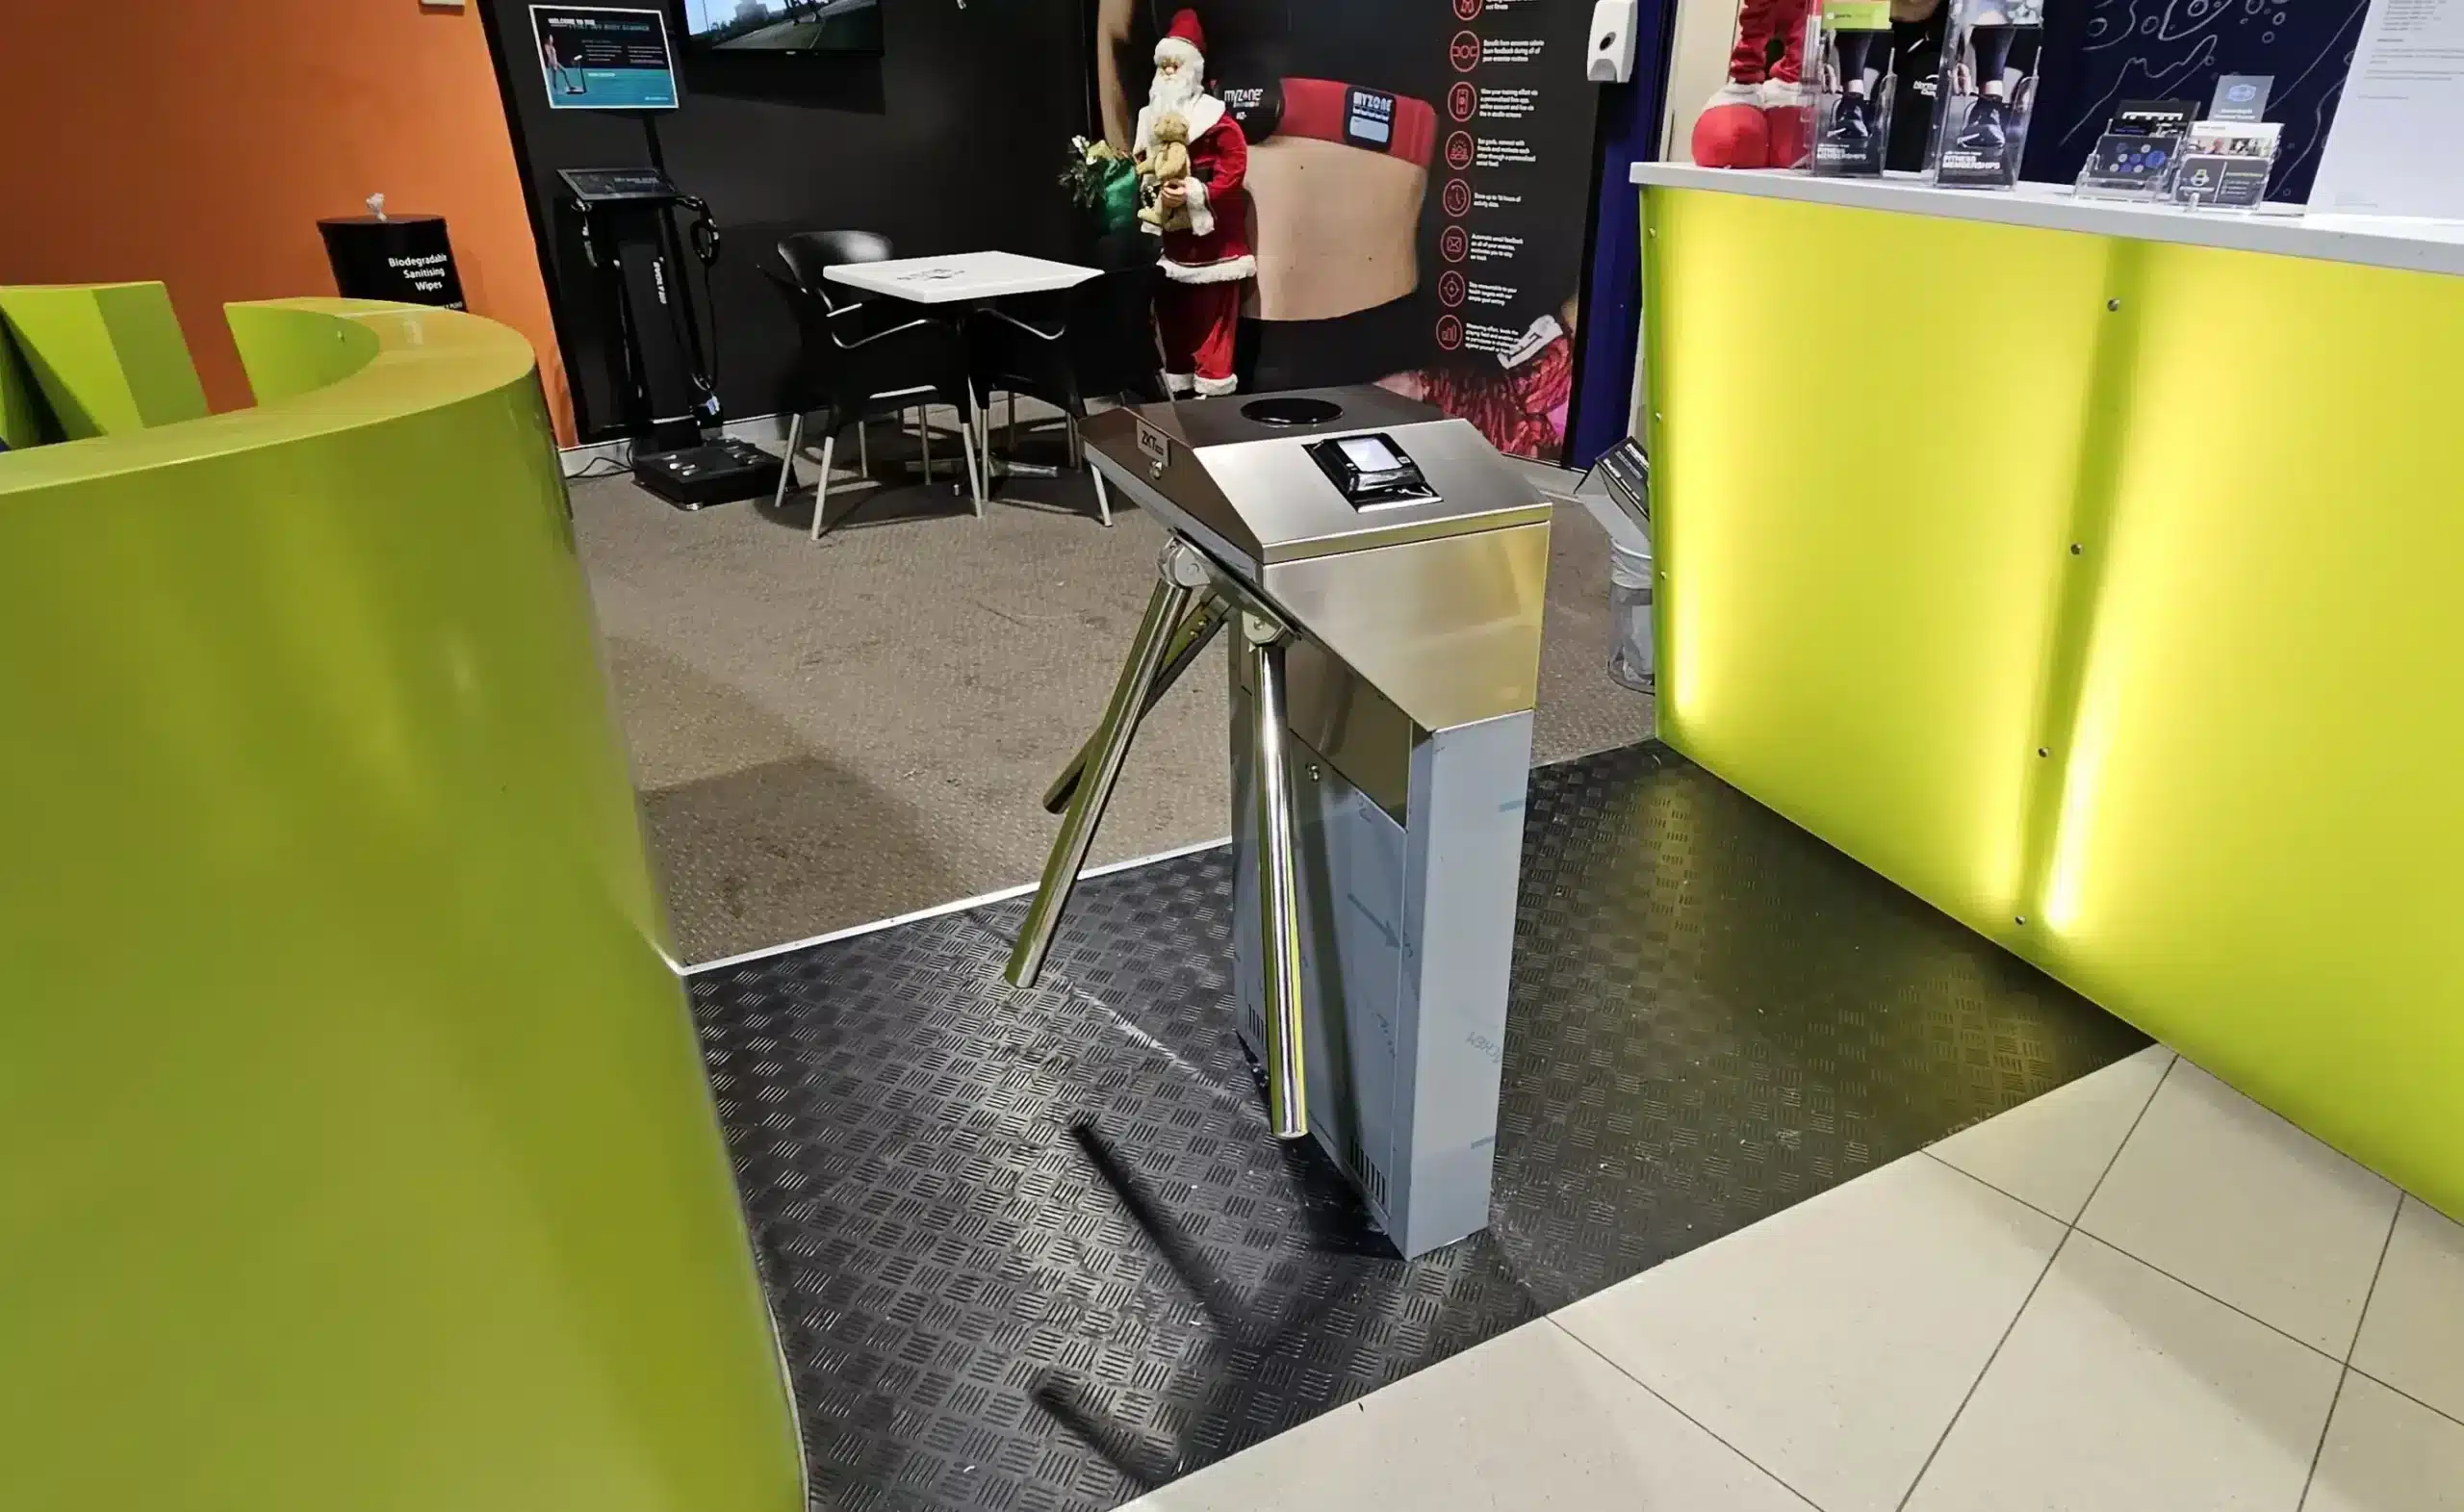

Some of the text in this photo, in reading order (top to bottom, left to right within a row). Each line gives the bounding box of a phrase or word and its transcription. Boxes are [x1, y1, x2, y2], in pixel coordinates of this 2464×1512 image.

[1352, 91, 1393, 112] MYZONE
[403, 268, 446, 279] Sanitising
[415, 281, 443, 292] Wipes
